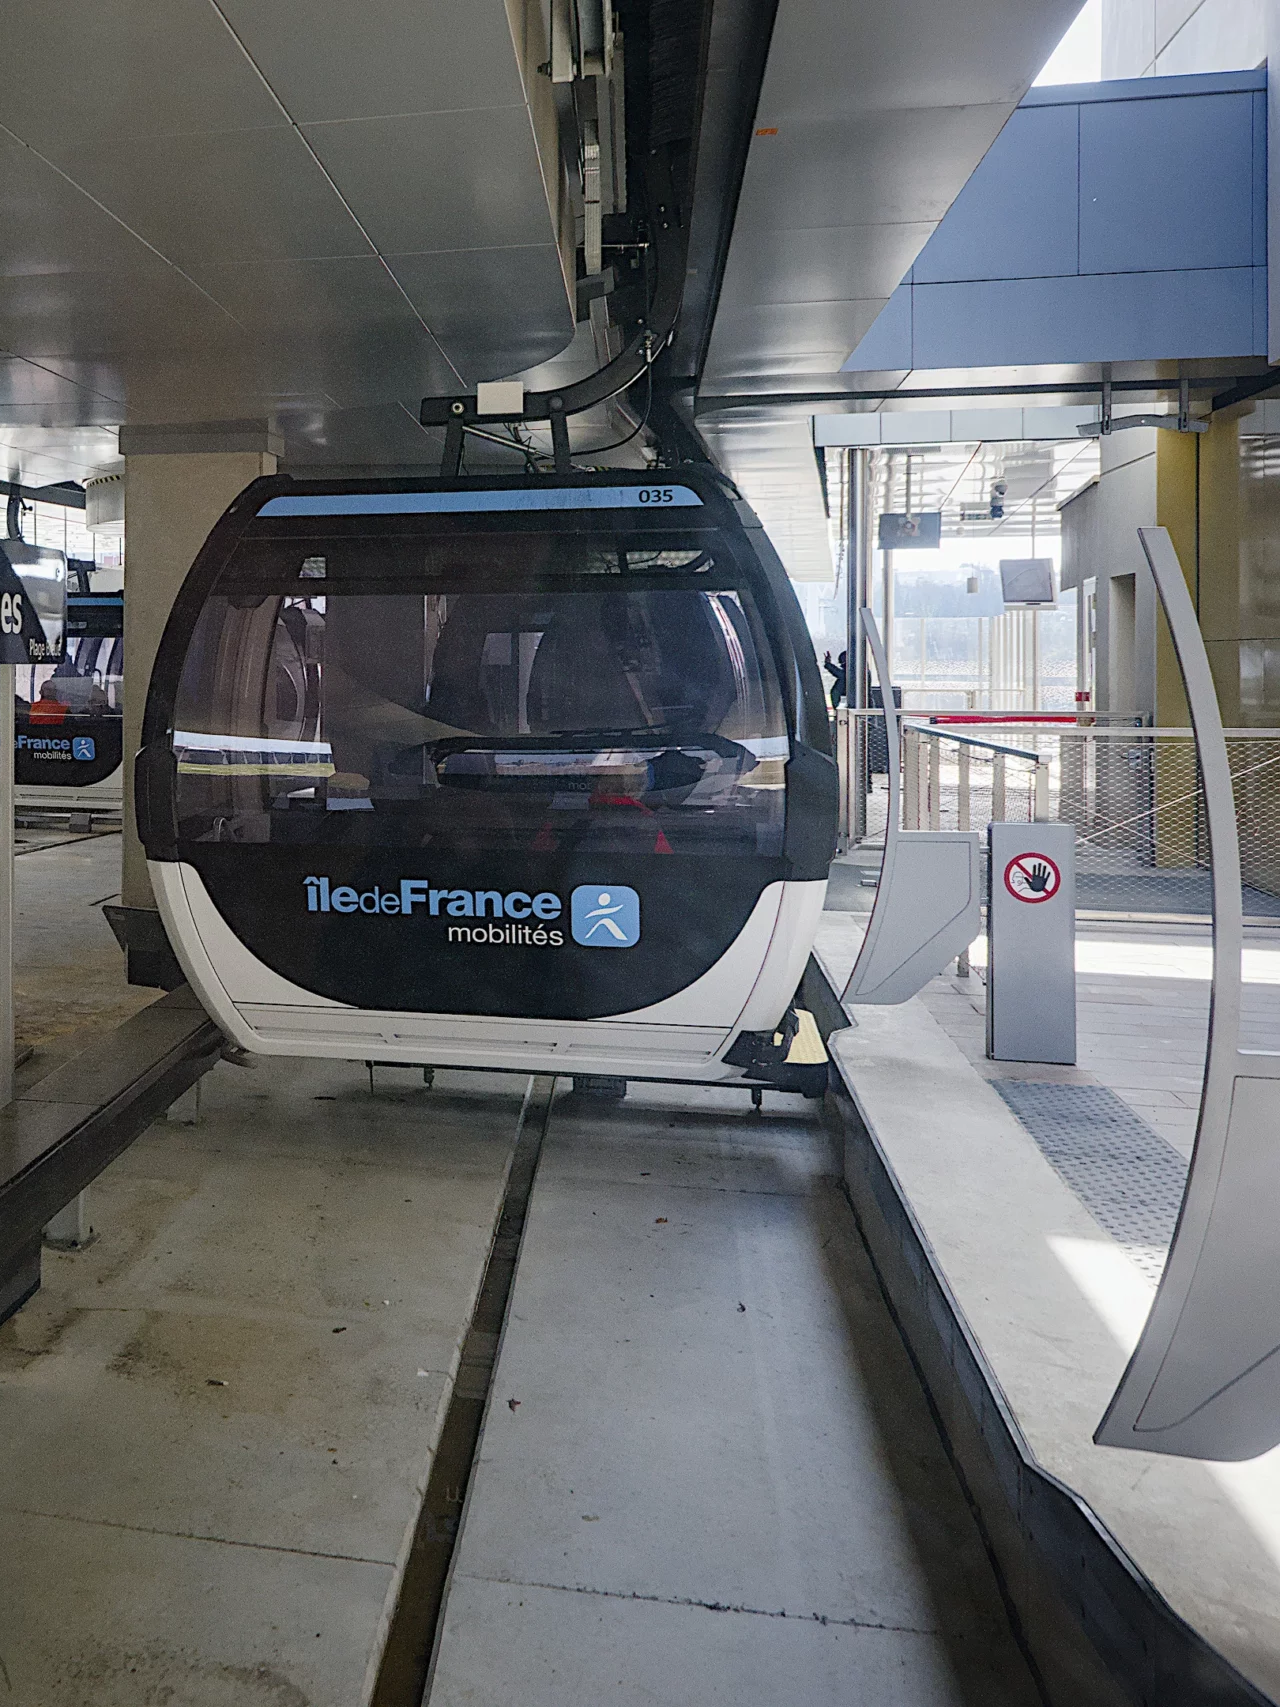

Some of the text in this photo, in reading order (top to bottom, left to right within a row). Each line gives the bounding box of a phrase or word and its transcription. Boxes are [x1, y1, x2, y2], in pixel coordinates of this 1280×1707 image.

[638, 489, 673, 503] 035
[33, 751, 72, 760] mobilités
[448, 924, 564, 946] mobilités
